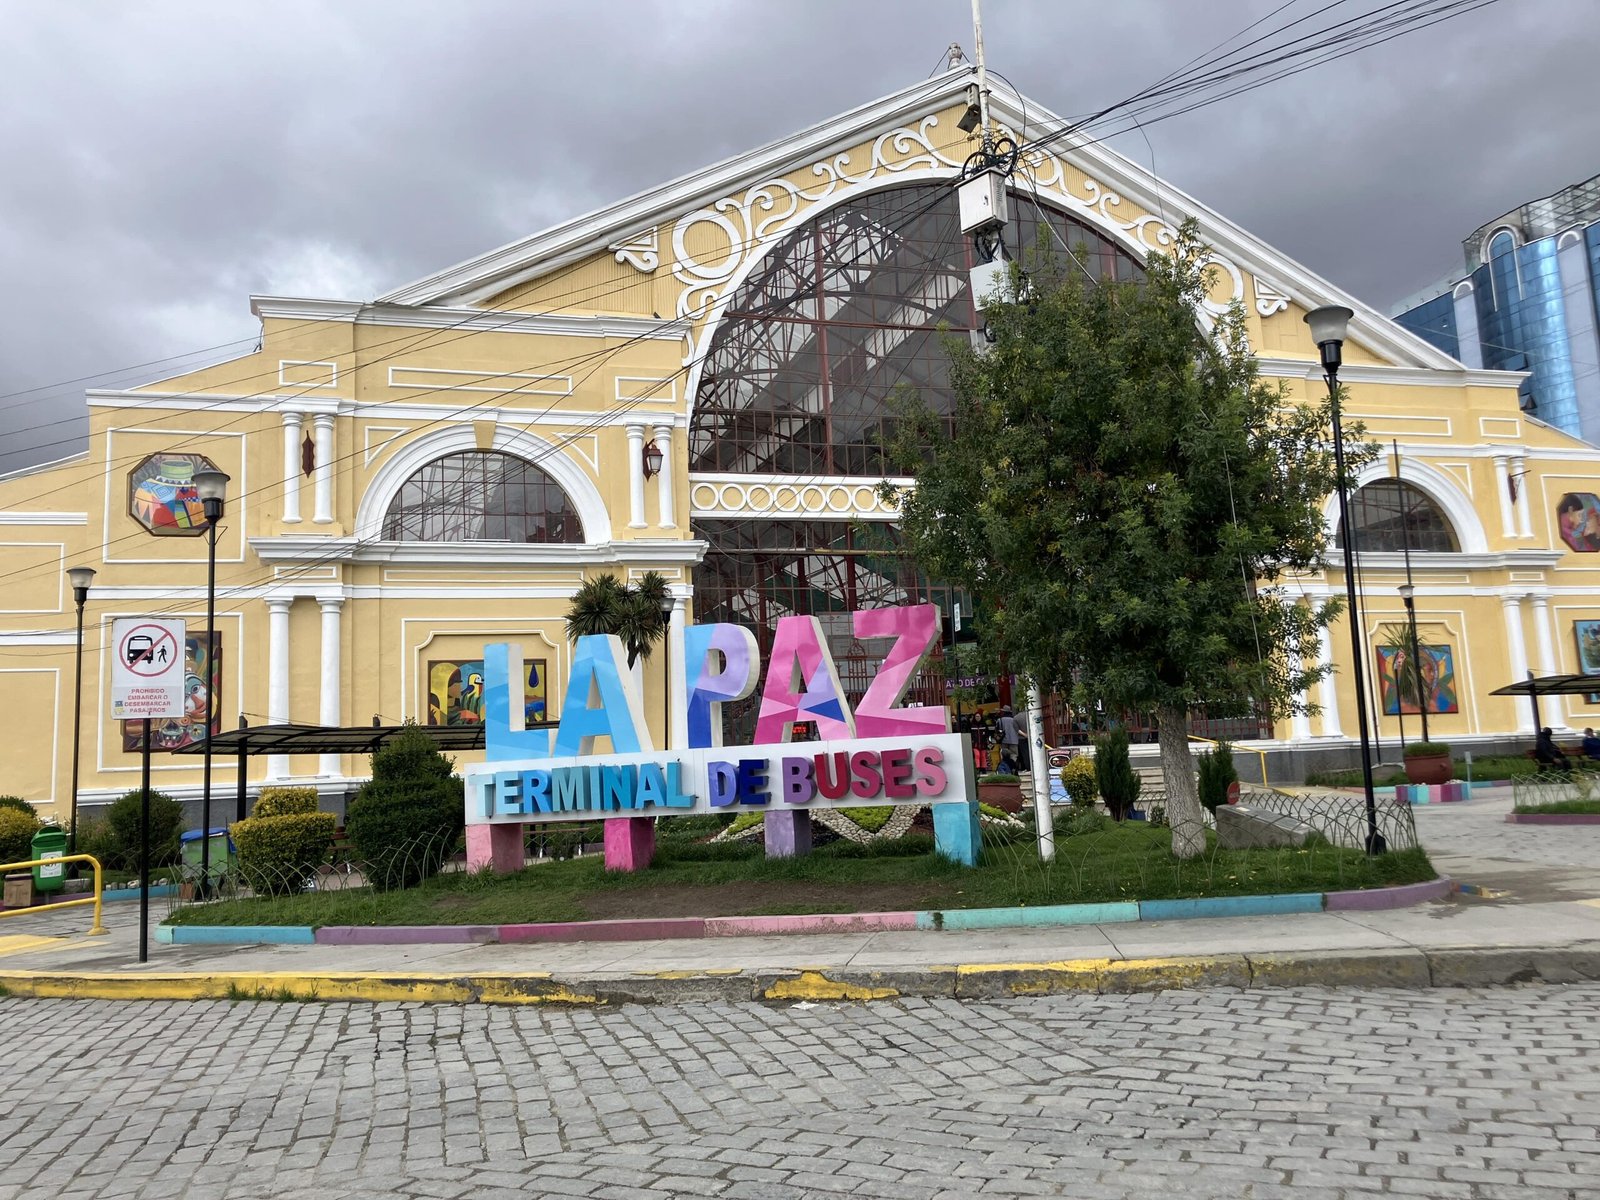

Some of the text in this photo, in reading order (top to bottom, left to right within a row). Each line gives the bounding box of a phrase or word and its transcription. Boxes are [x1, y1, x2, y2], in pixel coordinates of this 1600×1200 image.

[484, 604, 950, 761] LA PAZ
[473, 747, 947, 817] TERMINAL DE BUSES
